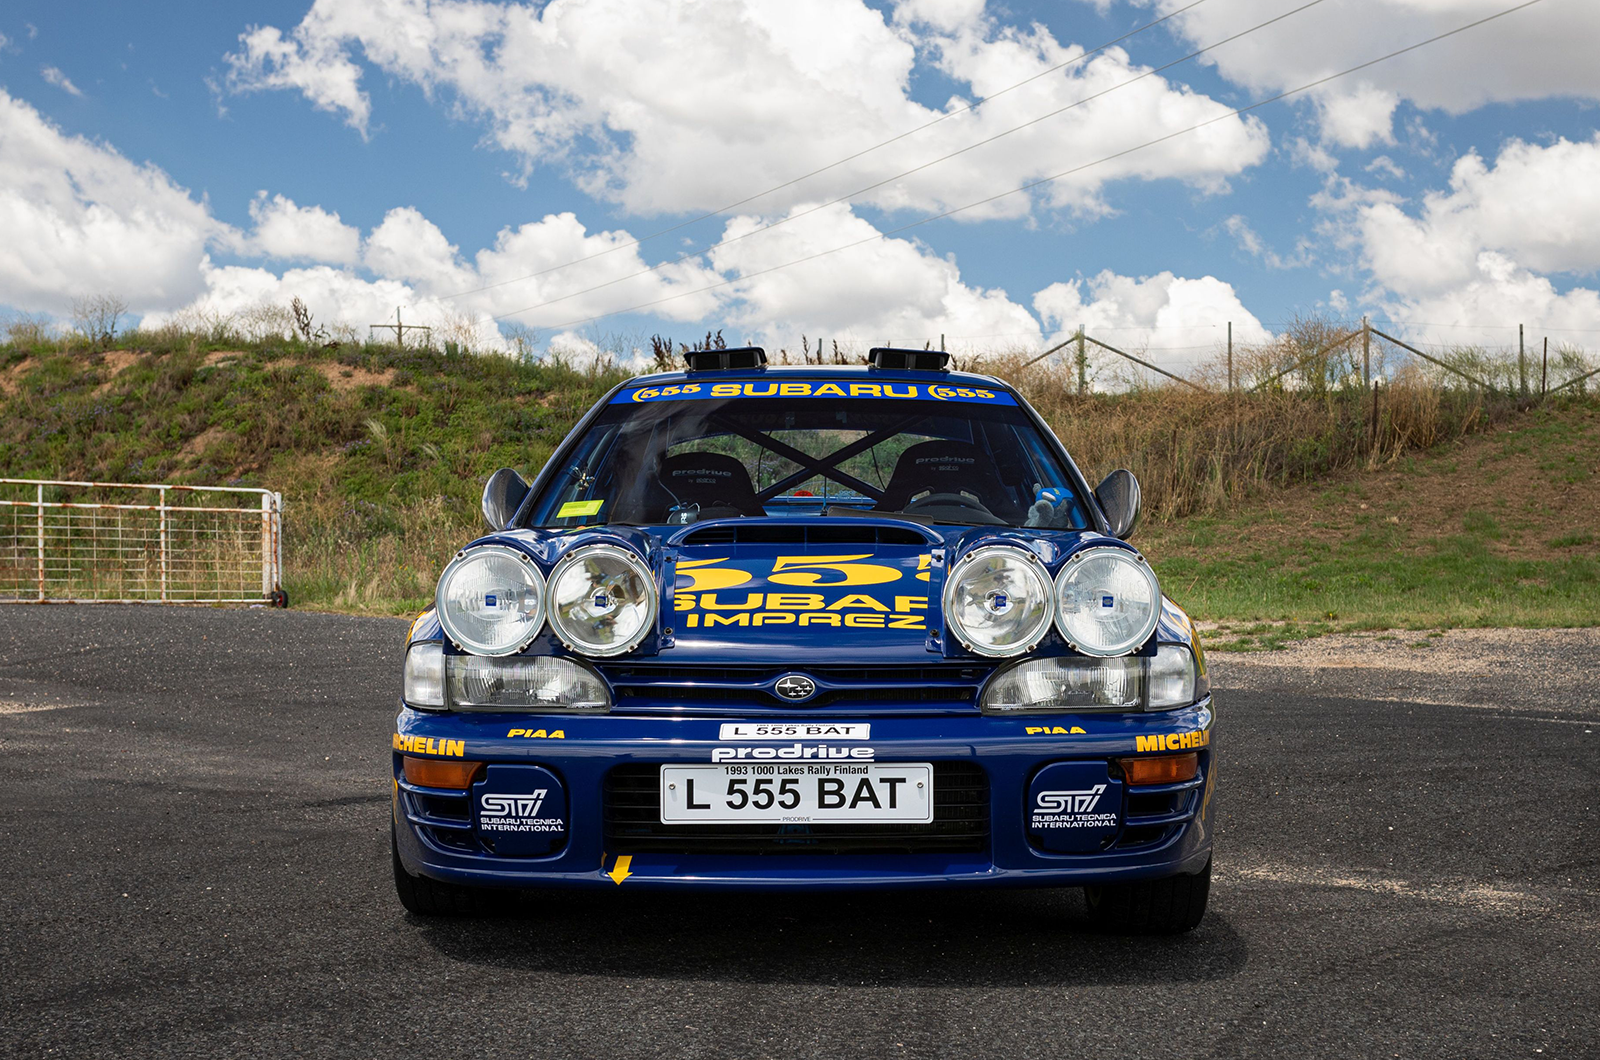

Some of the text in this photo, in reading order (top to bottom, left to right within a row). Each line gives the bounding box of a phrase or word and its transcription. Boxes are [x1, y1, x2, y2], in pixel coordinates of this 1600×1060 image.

[710, 383, 918, 398] SUBARU
[672, 469, 732, 477] prodrive
[507, 729, 565, 739] PIAA
[734, 727, 856, 735] L 555 BAT
[1025, 726, 1087, 735] PIAA
[711, 743, 875, 763] prodrive
[725, 766, 869, 776] 1993 1000 Lakes Rally Finland
[686, 777, 907, 810] L 555 BAT
[480, 817, 520, 825] SUBARU
[1032, 813, 1117, 822] SUBARU TECNICA
[481, 824, 565, 832] INTERNATIONAL
[1031, 820, 1117, 829] INTERNATIONAL
